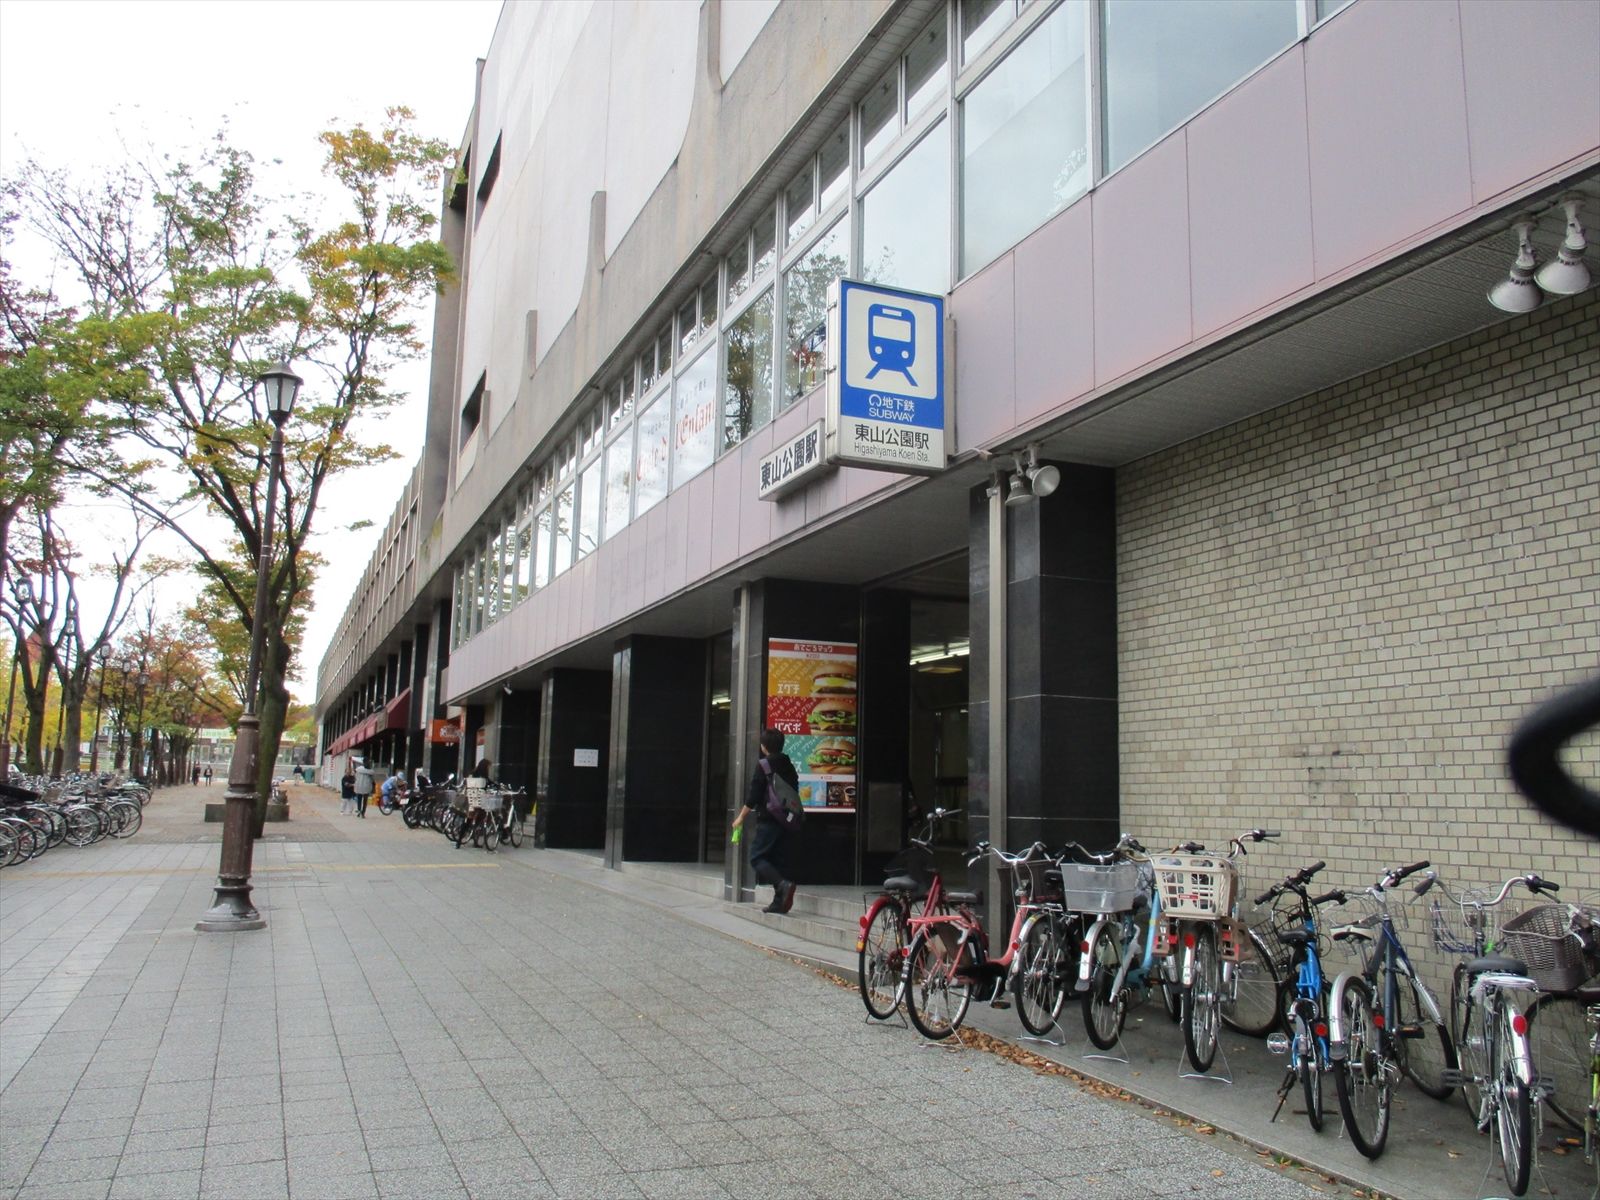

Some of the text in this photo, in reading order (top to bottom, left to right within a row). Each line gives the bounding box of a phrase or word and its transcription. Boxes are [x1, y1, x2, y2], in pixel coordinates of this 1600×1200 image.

[882, 397, 915, 412] 地下鉄
[868, 408, 915, 422] SUBWAY
[855, 424, 930, 450] 東山公園駅
[761, 430, 818, 490] 東山公園駅
[854, 442, 930, 462] Higashiyama Koen Sta.
[777, 683, 800, 694] エグチ
